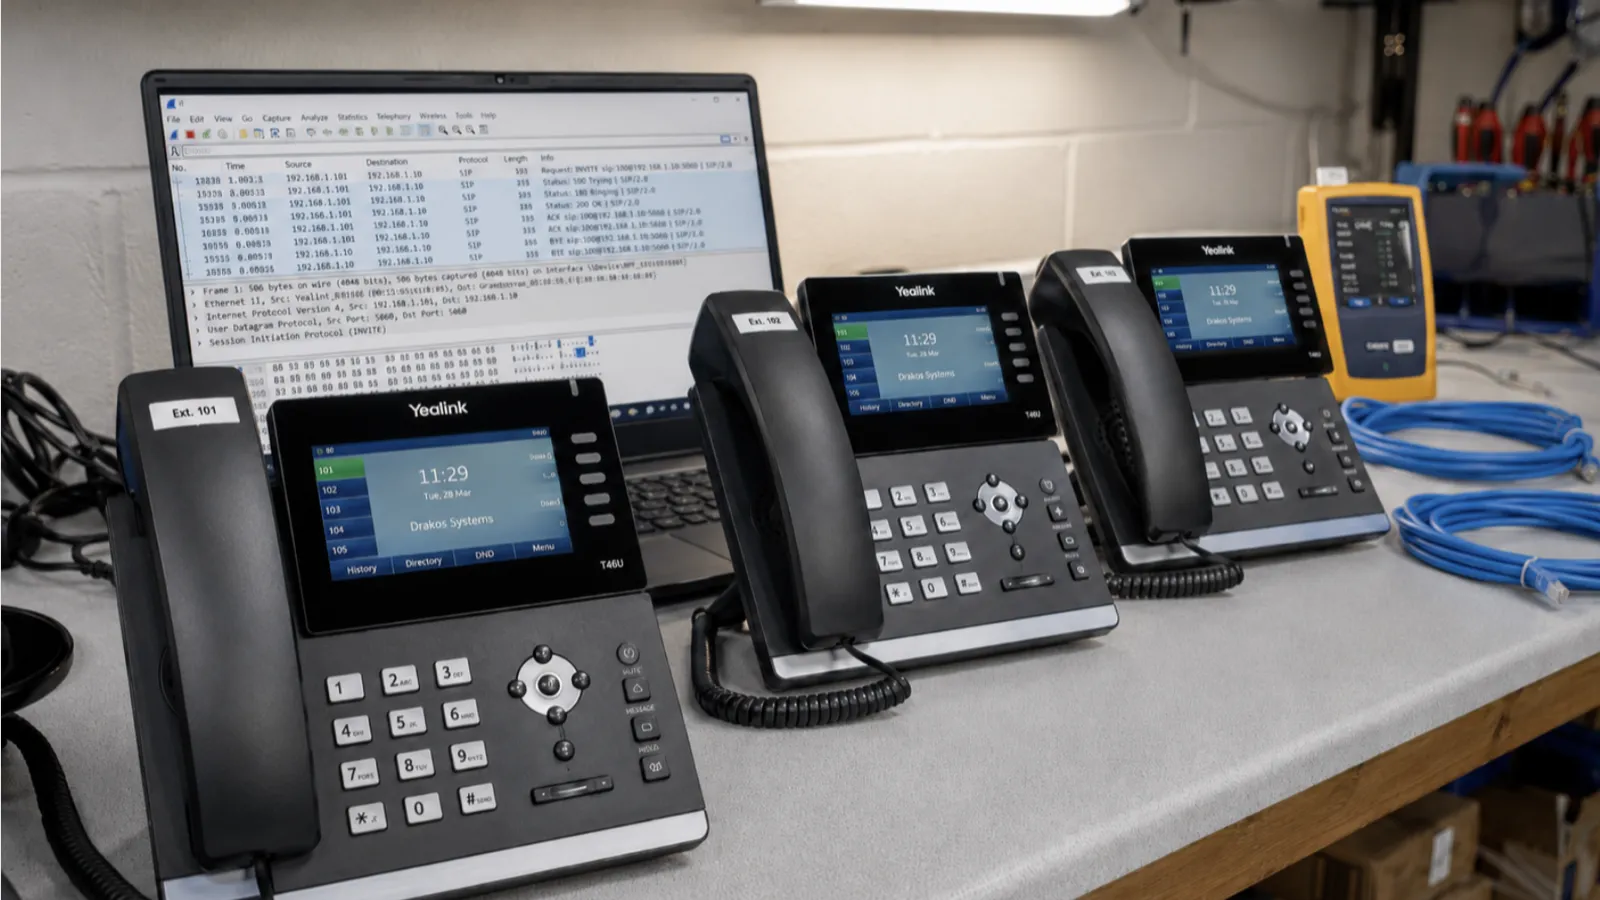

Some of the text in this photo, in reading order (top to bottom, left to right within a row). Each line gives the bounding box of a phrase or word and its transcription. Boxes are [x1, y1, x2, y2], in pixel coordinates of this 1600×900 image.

[166, 111, 497, 124] File Edit View Go Capture Analyze Statistics Telephony Wireless Tools Help
[172, 154, 554, 173] No. Time Source Destination Protocol Length Info
[286, 173, 347, 182] 192.168.1.101
[368, 171, 422, 179] 192.168.1.10
[288, 185, 349, 195] 192.168.1.101
[369, 183, 424, 192] 192.168.1.10
[289, 198, 351, 208] 192.168.1.101
[203, 287, 228, 296] Frame
[268, 283, 293, 292] bytes
[415, 274, 438, 284] bytes
[441, 272, 478, 281] captured
[1209, 284, 1236, 296] 11:29
[895, 285, 935, 297] Yealink
[204, 295, 290, 308] Ethernet Src:
[207, 312, 247, 321] Internet
[252, 308, 291, 318] Protocol
[297, 305, 330, 314] Version
[349, 302, 368, 310] Src:
[208, 325, 228, 333] User
[233, 322, 273, 334] Datagram
[278, 318, 322, 328] Protocol,
[209, 326, 386, 347] Session Initiation Protocol (INVITE)
[903, 333, 937, 346] 11:29
[926, 369, 955, 380] Systems
[172, 406, 216, 418] Ext. 101
[409, 400, 468, 418] Yealink
[319, 466, 334, 475] 101
[419, 465, 469, 485] 11:29
[322, 485, 337, 494] 102
[424, 491, 442, 501] Tue,
[455, 488, 472, 498] Mar
[895, 491, 903, 501] 2
[929, 487, 936, 497] 3
[325, 506, 341, 514] 103
[410, 514, 494, 532] Drakos Systems
[906, 521, 913, 531] 5
[940, 517, 946, 527] 6
[329, 526, 344, 535] 104
[332, 545, 348, 555] 105
[347, 542, 555, 575] History Directory DND Menu
[880, 556, 887, 566] 7
[916, 552, 923, 562] 8
[600, 559, 624, 570] T46U
[928, 583, 935, 593] 0
[442, 666, 451, 679] 3
[389, 673, 399, 688] 2
[335, 681, 342, 694] 1
[450, 707, 460, 721] 6
[396, 716, 405, 729] 5
[341, 724, 351, 738] 4
[458, 749, 467, 763] 9
[404, 758, 414, 772] 8
[348, 767, 356, 781] 7
[466, 792, 475, 806] #
[414, 801, 424, 815] 0
